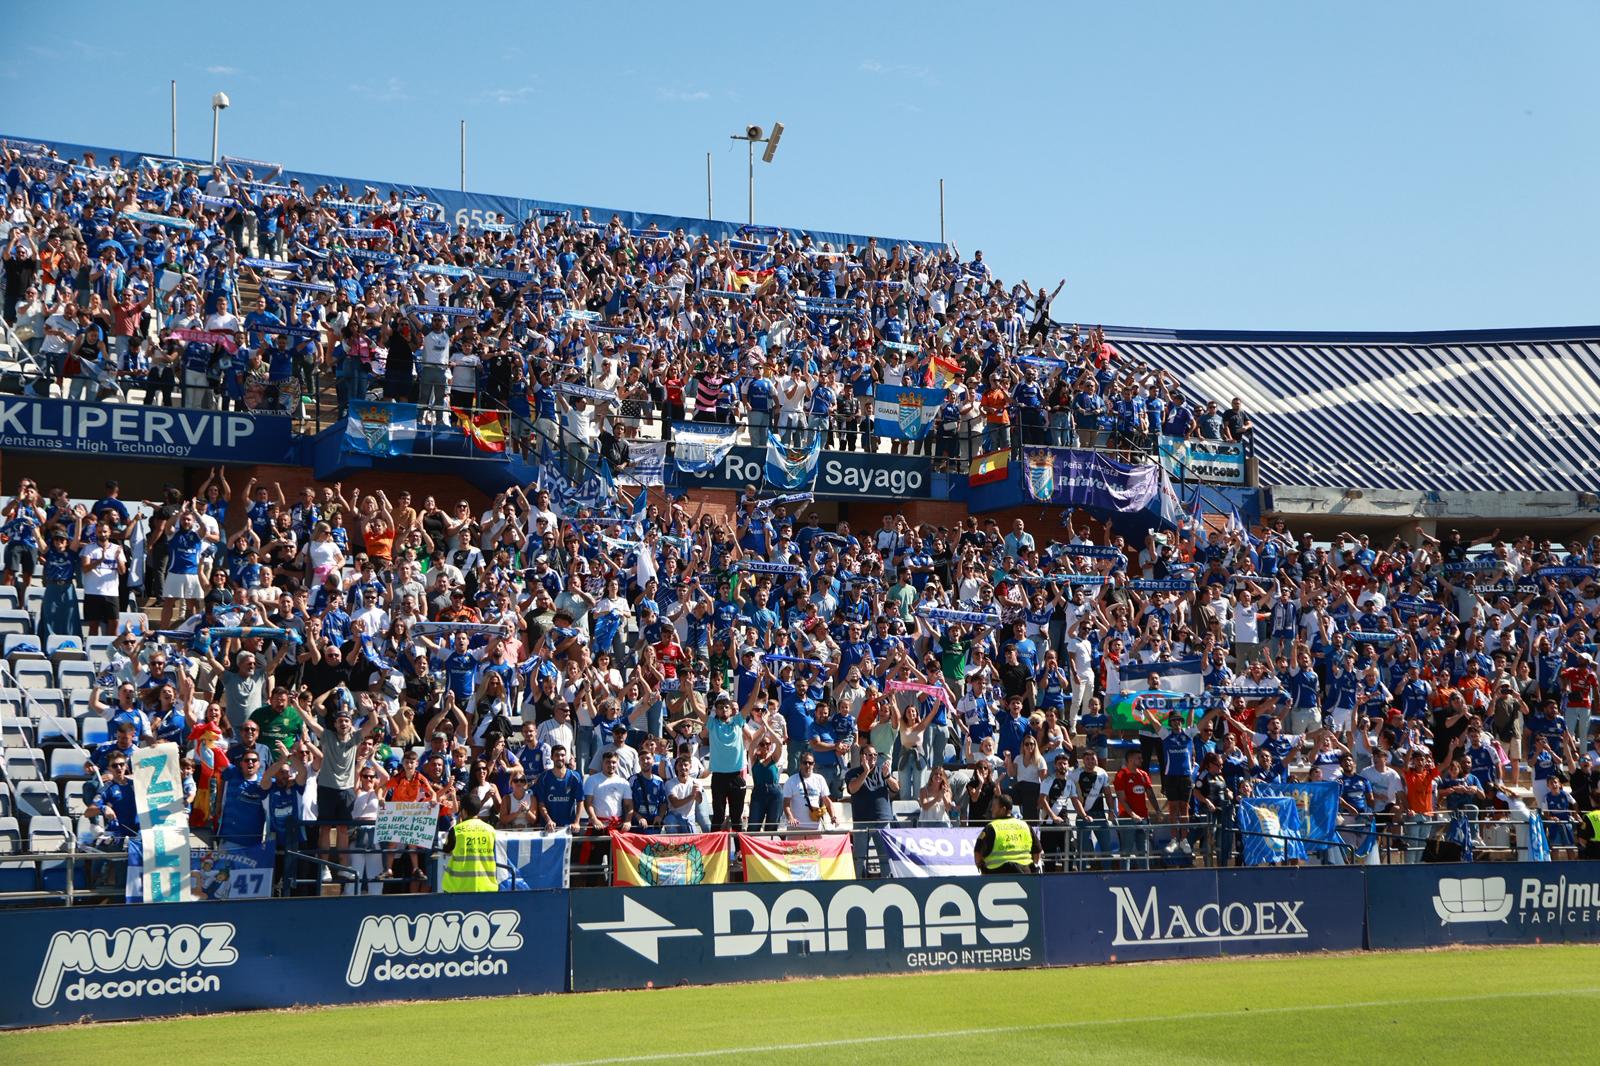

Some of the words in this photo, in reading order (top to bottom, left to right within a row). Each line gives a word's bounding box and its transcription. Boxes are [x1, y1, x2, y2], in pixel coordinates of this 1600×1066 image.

[0, 401, 255, 447] KLIPERVIP
[76, 440, 108, 452] High
[114, 441, 191, 456] Technology
[826, 460, 922, 494] Sayago
[749, 562, 779, 571] XEREZ
[1138, 581, 1171, 589] XEREZ
[1218, 686, 1257, 694] XEREZ
[1146, 698, 1166, 708] CD
[1186, 697, 1220, 707] 1947
[466, 837, 487, 845] 2119
[233, 874, 264, 894] 47
[712, 881, 1029, 957] DAMAS
[346, 909, 524, 987] MUÑOZ
[907, 952, 958, 967] GRUPO
[961, 946, 1032, 964] INTERBUS
[32, 922, 239, 1009] MUÑOZ
[374, 953, 508, 982] decoración
[65, 970, 220, 1001] decoración
